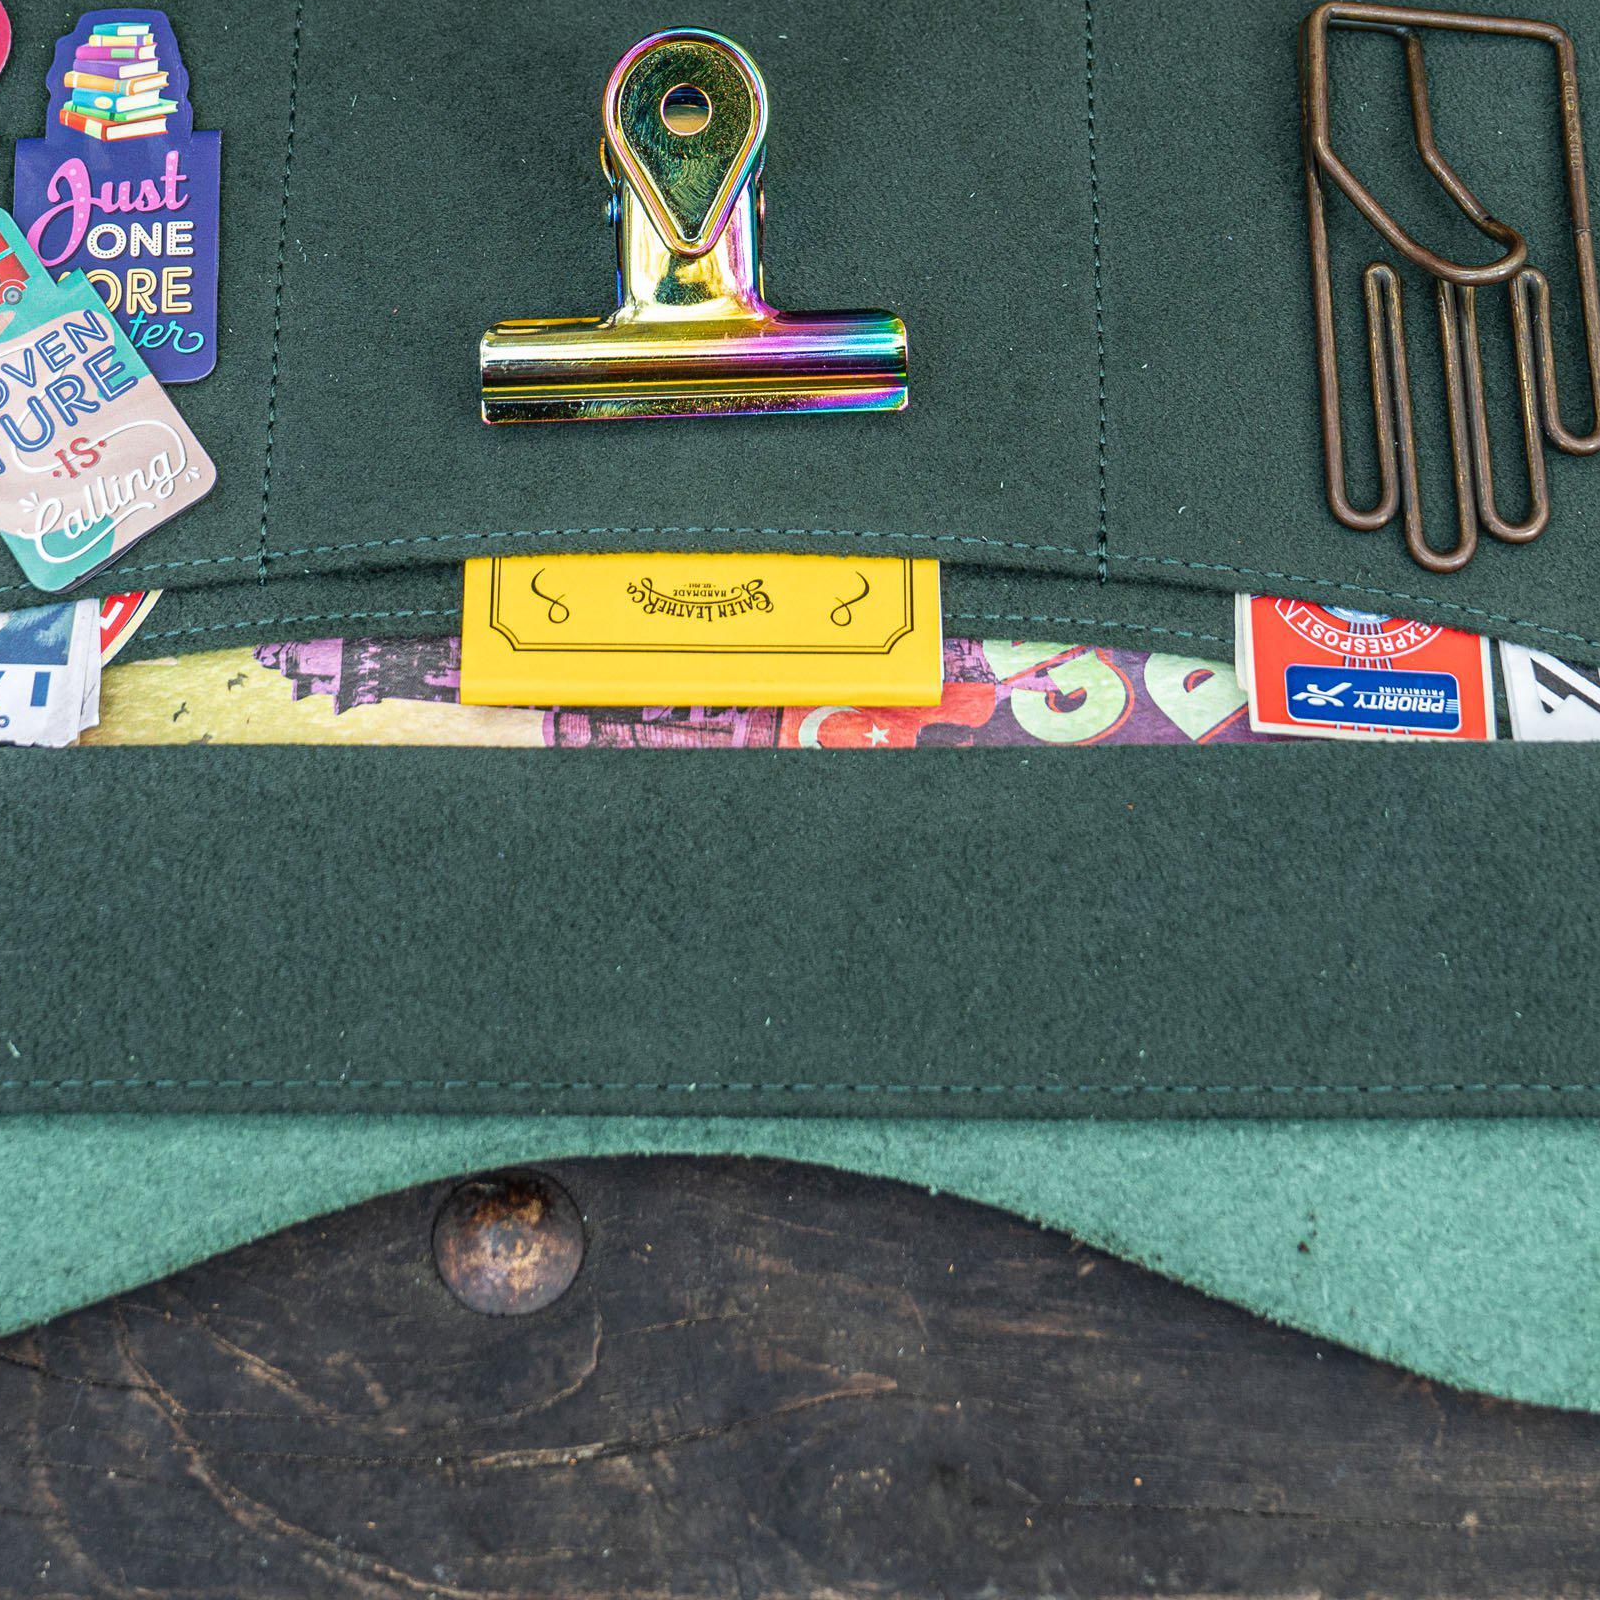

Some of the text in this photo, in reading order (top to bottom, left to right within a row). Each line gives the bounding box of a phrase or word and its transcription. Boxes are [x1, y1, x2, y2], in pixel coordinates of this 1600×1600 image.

[26, 150, 189, 267] Just
[86, 220, 194, 260] ONE
[57, 266, 193, 315] ORE
[17, 449, 176, 564] Calling
[641, 577, 714, 623] LEATHER
[673, 589, 727, 598] HANDMADE
[717, 578, 775, 619] GALEN
[1296, 616, 1432, 655] EXPRESPOST
[1352, 693, 1445, 714] PRIORITY
[1378, 685, 1445, 697] PRIORITAIRE
